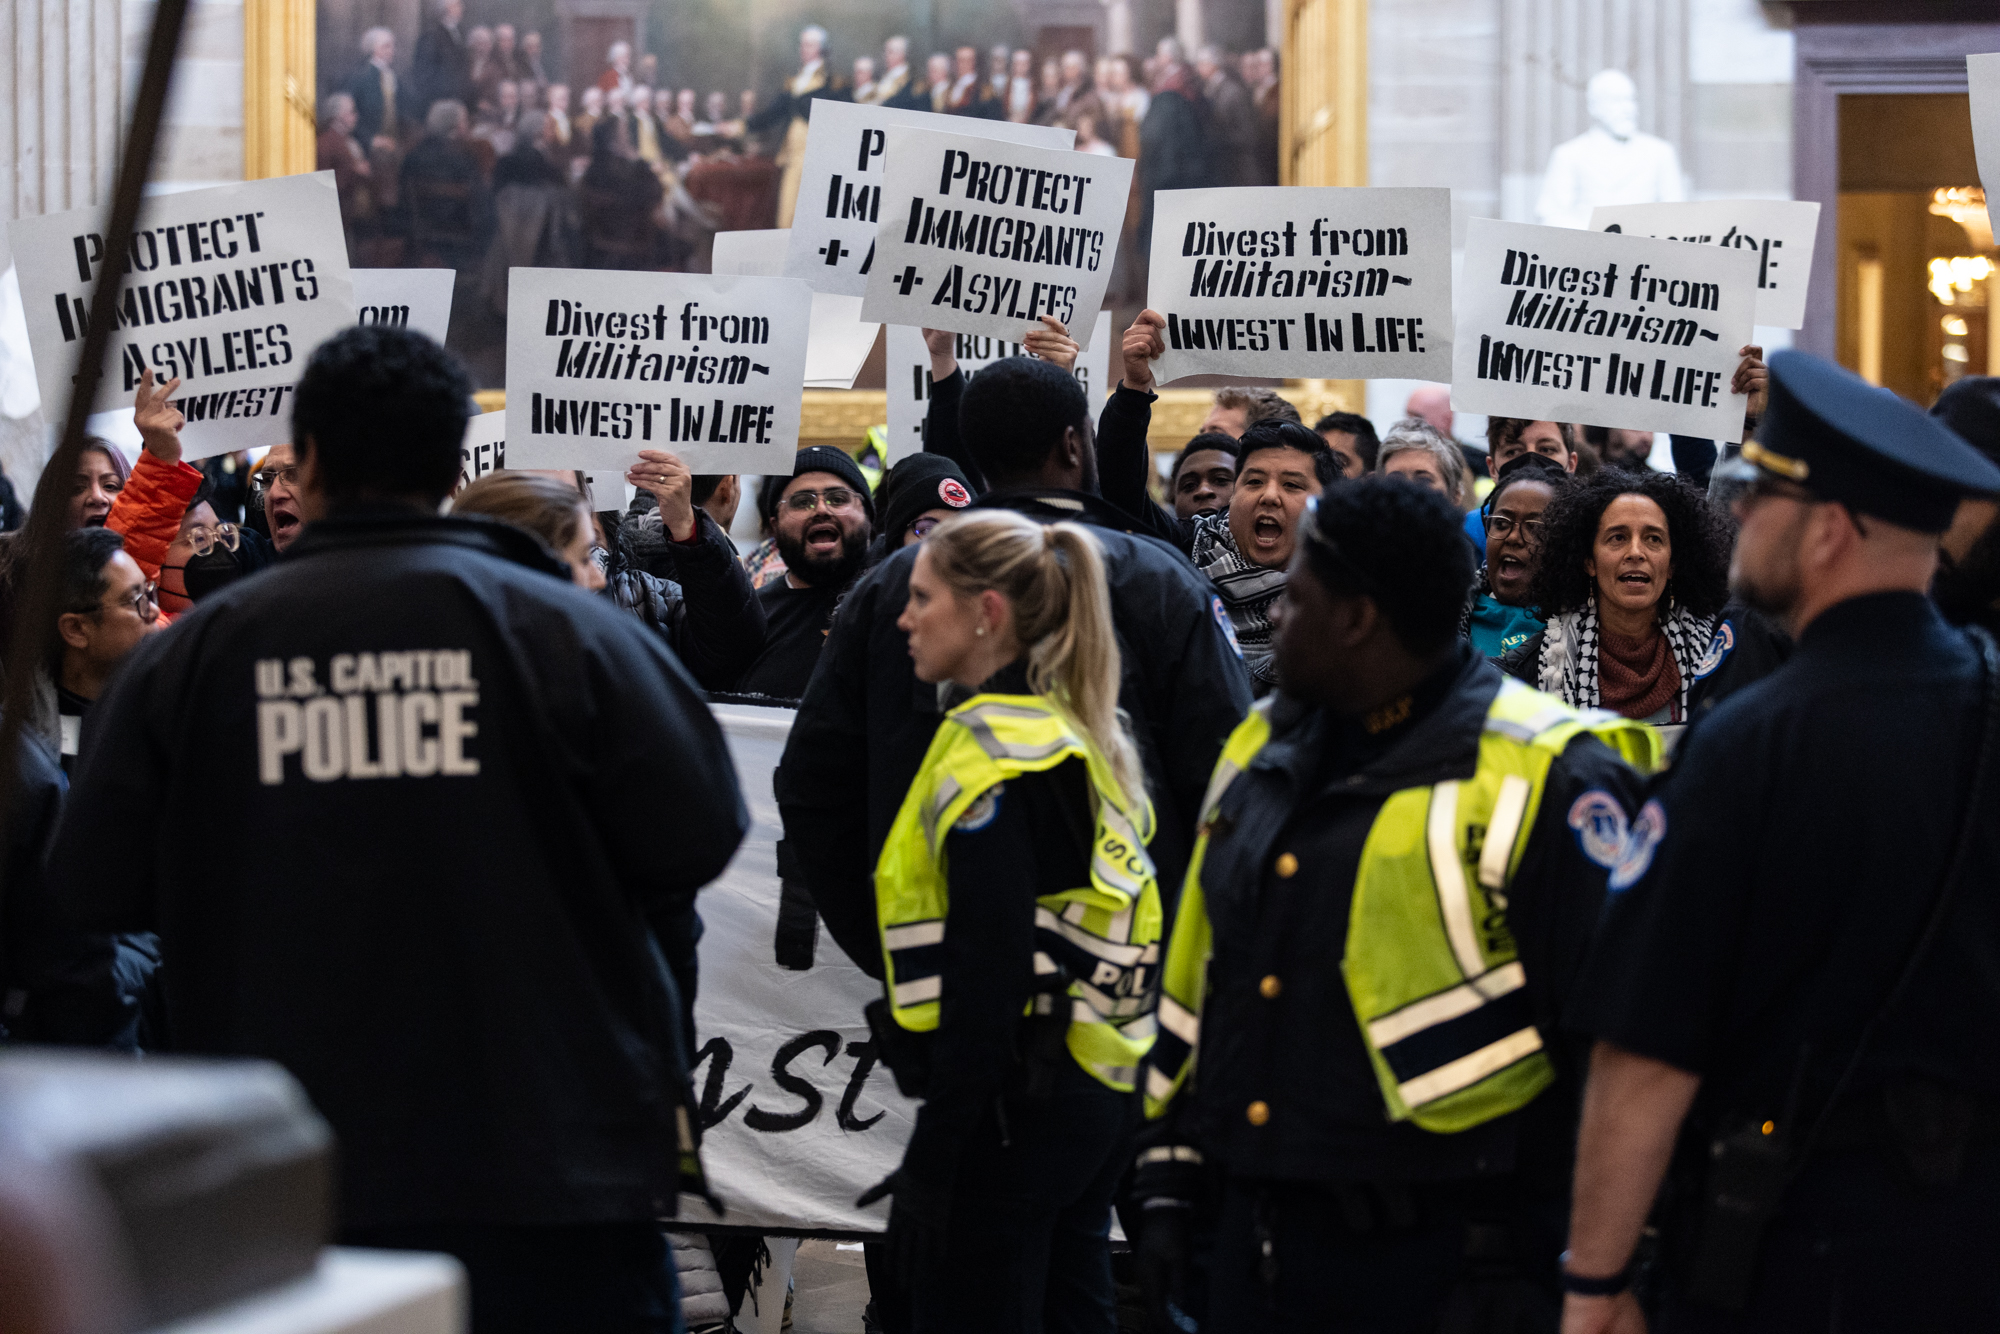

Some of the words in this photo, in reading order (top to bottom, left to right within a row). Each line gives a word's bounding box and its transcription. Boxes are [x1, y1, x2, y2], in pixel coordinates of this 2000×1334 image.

[939, 149, 1092, 216] PROTECT
[73, 211, 265, 283] POTECT
[904, 196, 1104, 272] IMMIGRANTS
[1182, 221, 1297, 257] Divest
[1310, 217, 1408, 256] from
[931, 264, 1077, 326] ASYLEES
[1500, 248, 1618, 299] Divest
[1630, 264, 1719, 312] from
[545, 299, 667, 341] Divest
[680, 302, 769, 344] from
[1168, 313, 1295, 351] INVEST
[1304, 312, 1344, 352] IN
[1352, 312, 1425, 353] LIFE
[122, 323, 294, 392] ASYLEES
[1477, 334, 1601, 392] INVEST
[1605, 353, 1645, 398] IN
[1650, 359, 1721, 408] LIFE
[531, 392, 661, 441] INVEST
[670, 398, 703, 442] IN
[709, 399, 774, 445] LIFE
[256, 656, 327, 698] U.S.
[330, 649, 480, 695] CAPITOL
[257, 690, 480, 786] POLICE
